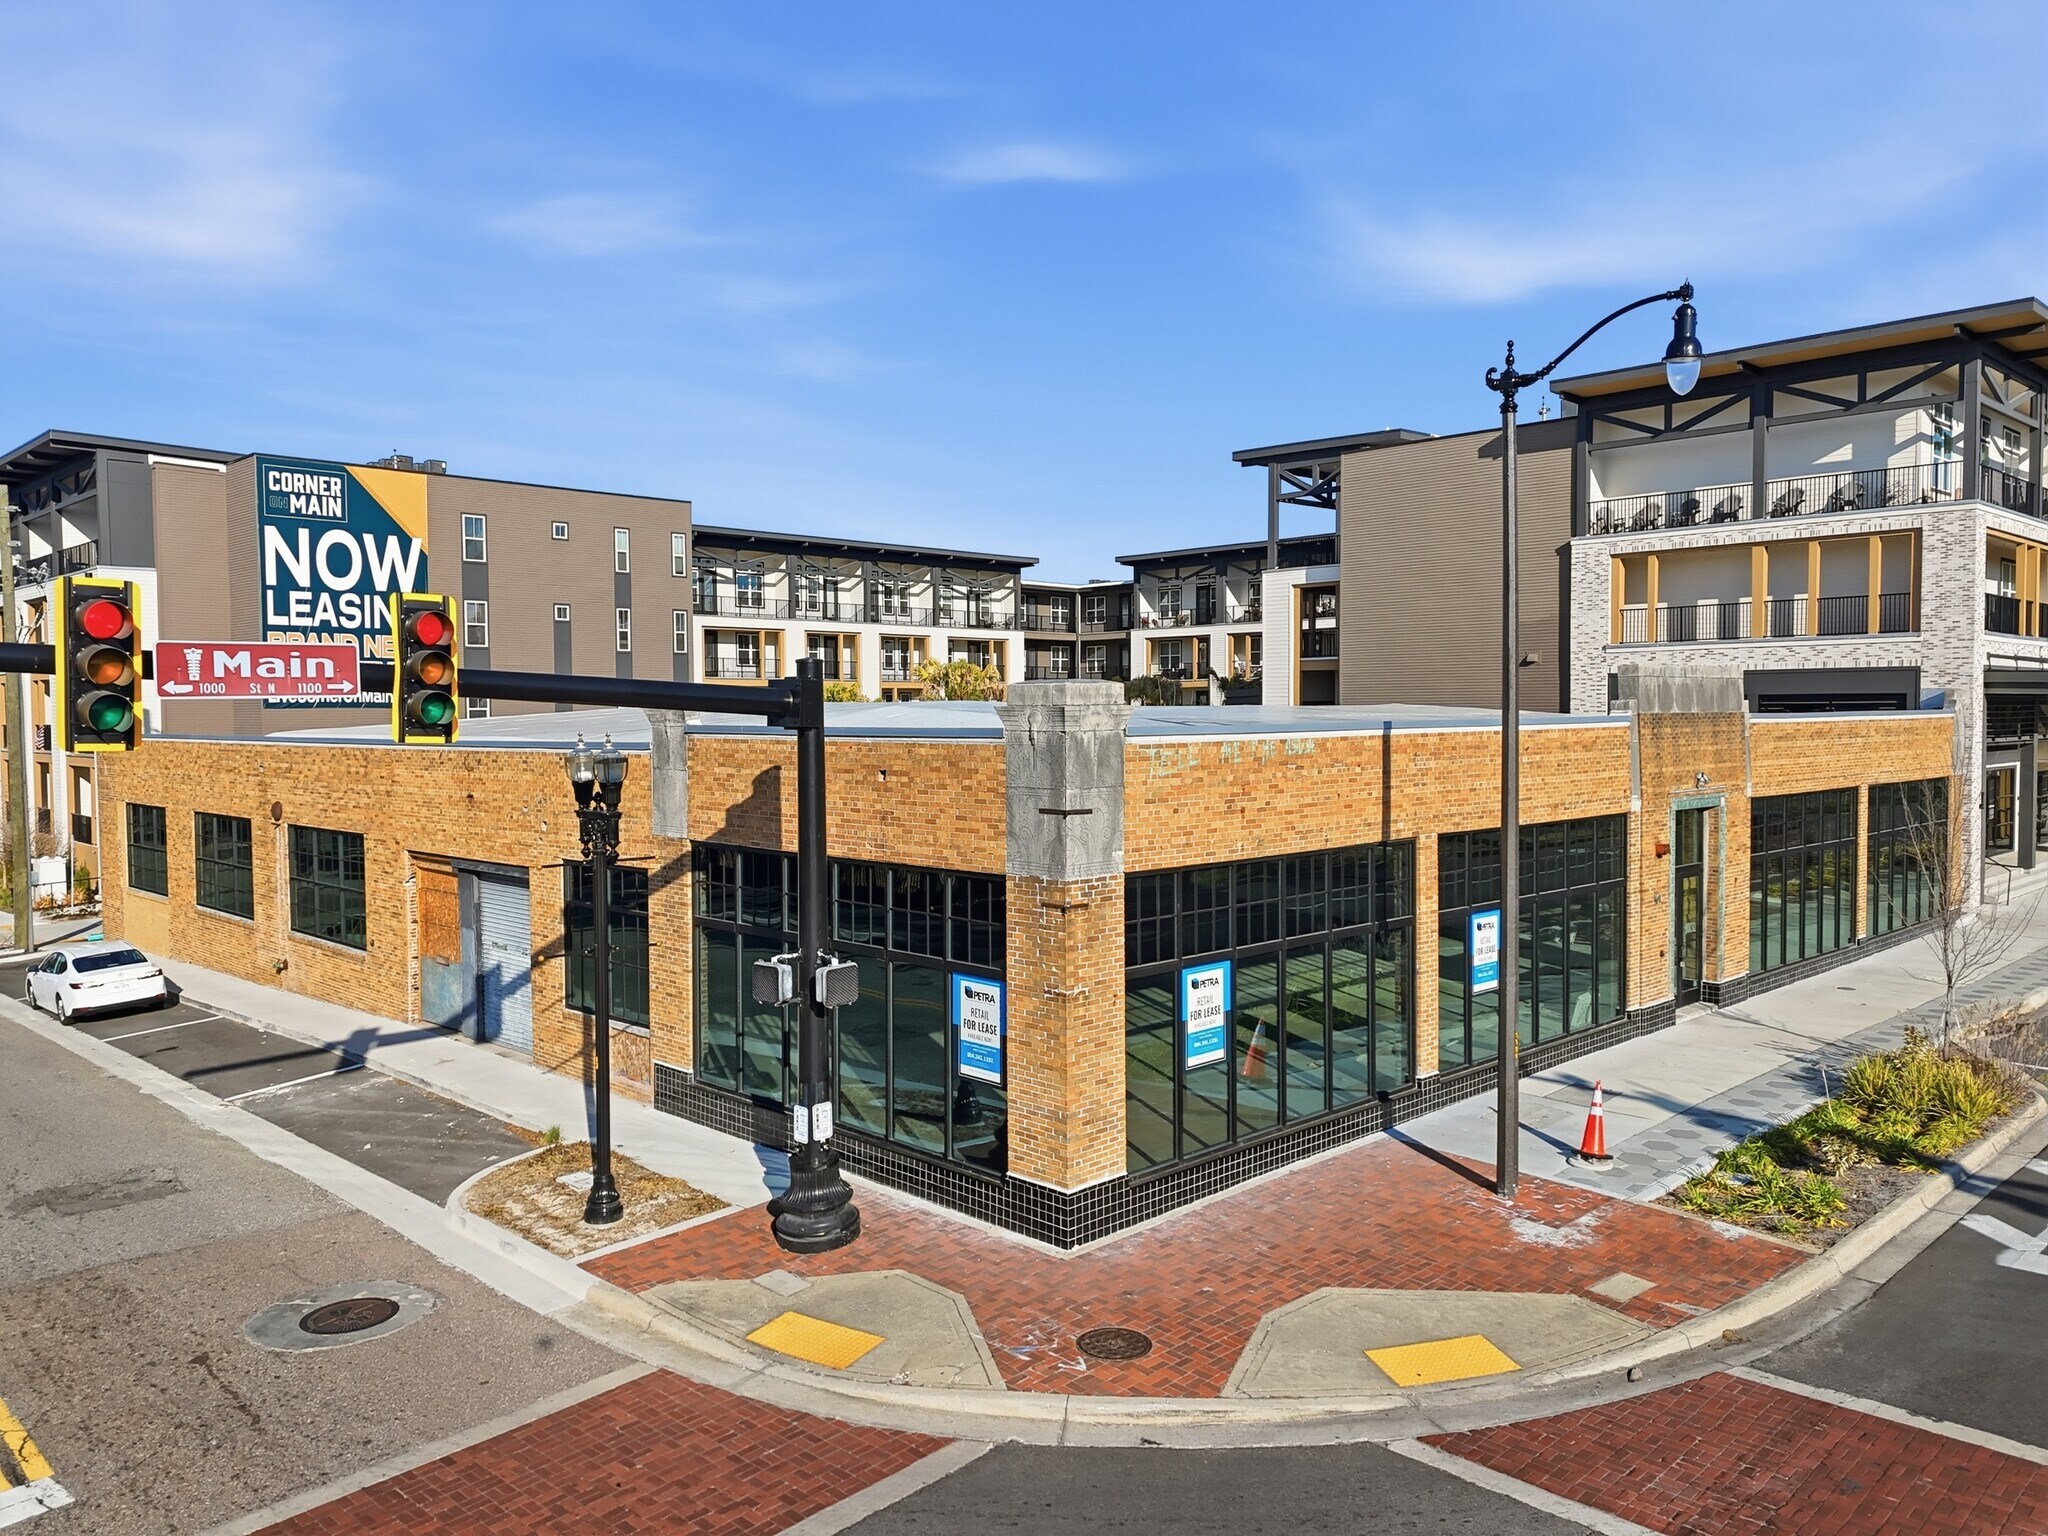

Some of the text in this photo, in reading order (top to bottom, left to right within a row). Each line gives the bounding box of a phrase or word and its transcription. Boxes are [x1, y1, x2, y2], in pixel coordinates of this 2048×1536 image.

[268, 471, 342, 497] CORNER
[269, 494, 342, 518] ON MAIN
[264, 525, 422, 593] NOW
[267, 589, 392, 629] LEASIN
[363, 634, 395, 659] NE
[213, 650, 335, 678] Main
[199, 682, 322, 694] 1000 St N 1100
[1200, 978, 1219, 988] PETRA
[973, 992, 995, 1003] PETRA
[971, 1007, 989, 1020] RETAIL
[1190, 1005, 1221, 1021] FOR LEASE
[964, 1019, 997, 1035] FOR LEASE
